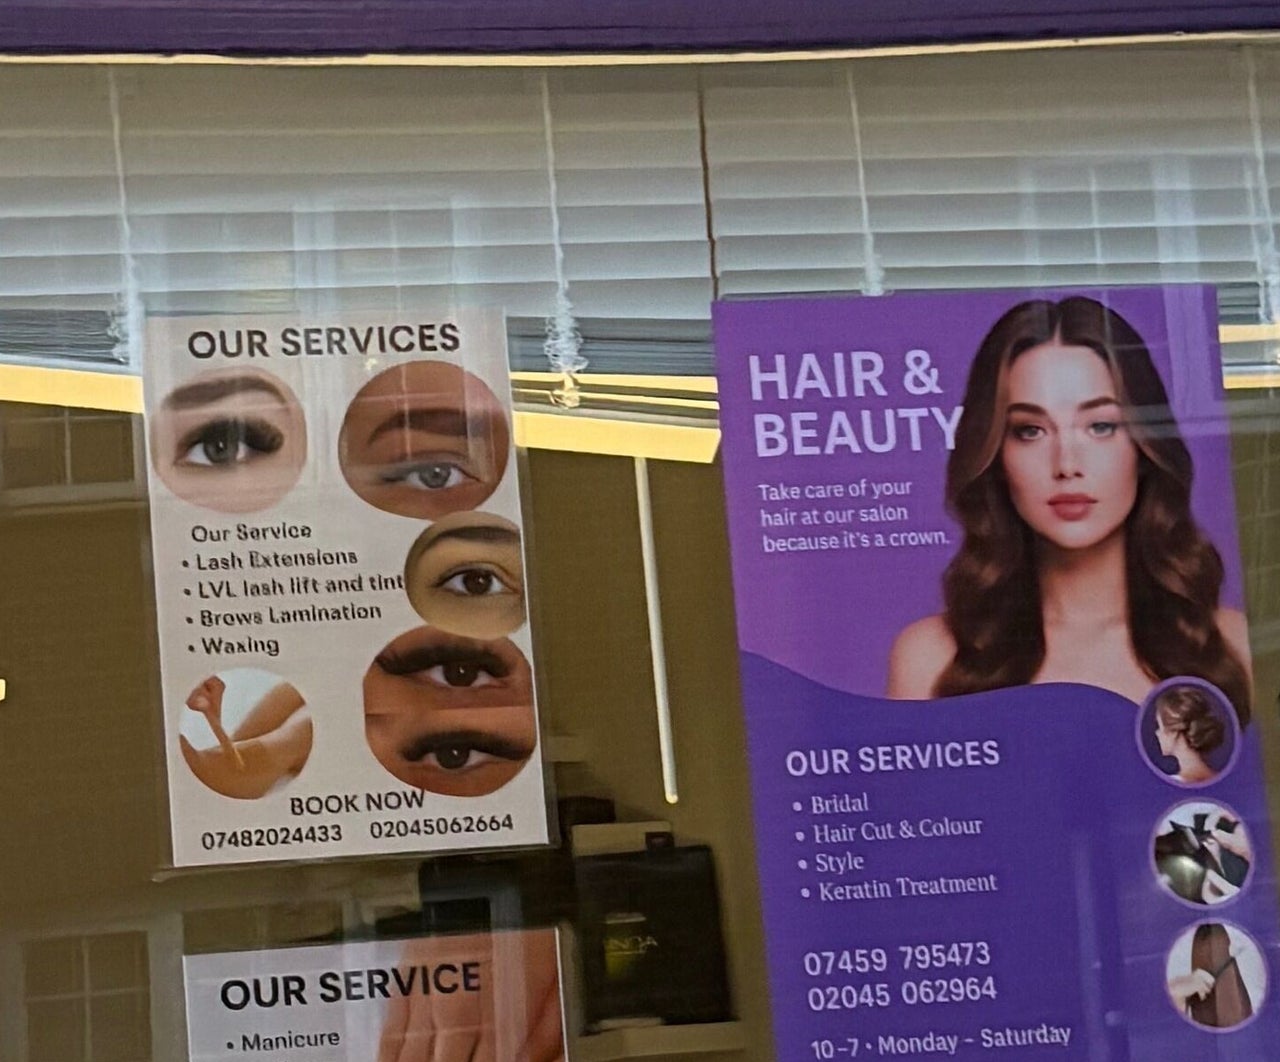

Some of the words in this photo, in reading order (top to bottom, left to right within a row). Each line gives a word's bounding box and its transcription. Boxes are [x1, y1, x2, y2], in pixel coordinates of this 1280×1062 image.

[188, 329, 271, 360] OUR
[280, 322, 461, 358] SERVICES
[748, 350, 888, 401] HAIR
[903, 348, 945, 395] &
[753, 405, 966, 458] BEAUTY
[758, 483, 801, 501] Take
[805, 484, 844, 499] care
[849, 478, 868, 497] of
[872, 481, 913, 499] your
[760, 507, 797, 527] hair
[801, 508, 820, 524] at
[824, 509, 856, 524] our
[860, 504, 910, 522] salon
[191, 525, 231, 543] Our
[236, 521, 312, 542] Service
[763, 534, 840, 553] because
[874, 534, 885, 547] a
[889, 529, 951, 548] crown.
[196, 553, 243, 572] Lash
[249, 548, 358, 569] Extensions
[198, 581, 237, 599] LVL
[243, 578, 284, 597] lash
[290, 575, 319, 595] lift
[325, 574, 363, 594] and
[369, 573, 405, 592] tint
[200, 608, 263, 628] Brows
[269, 603, 382, 625] Lamination
[202, 635, 280, 657] Waxing
[785, 748, 852, 777] OUR
[858, 739, 1001, 774] SERVICES
[290, 794, 360, 816] BOOK
[365, 789, 426, 811] NOW
[811, 792, 870, 815] Bridal
[201, 823, 343, 850] 07482024433
[370, 813, 515, 840] 02045062664
[813, 822, 857, 844] Hair
[860, 820, 895, 841] Cut
[899, 819, 917, 839] &
[919, 816, 984, 838] Colour
[815, 851, 865, 875] Style
[819, 879, 892, 902] Keratin
[896, 873, 999, 897] Treatment
[803, 948, 888, 977] 07459
[898, 941, 992, 971] 795473
[220, 973, 308, 1011] OUR
[319, 961, 482, 1004] SERVICE
[808, 983, 891, 1012] 02045
[901, 976, 998, 1004] 062964
[241, 1029, 341, 1052] Manicure
[877, 1032, 959, 1056] Monday
[980, 1022, 1072, 1049] Saturday
